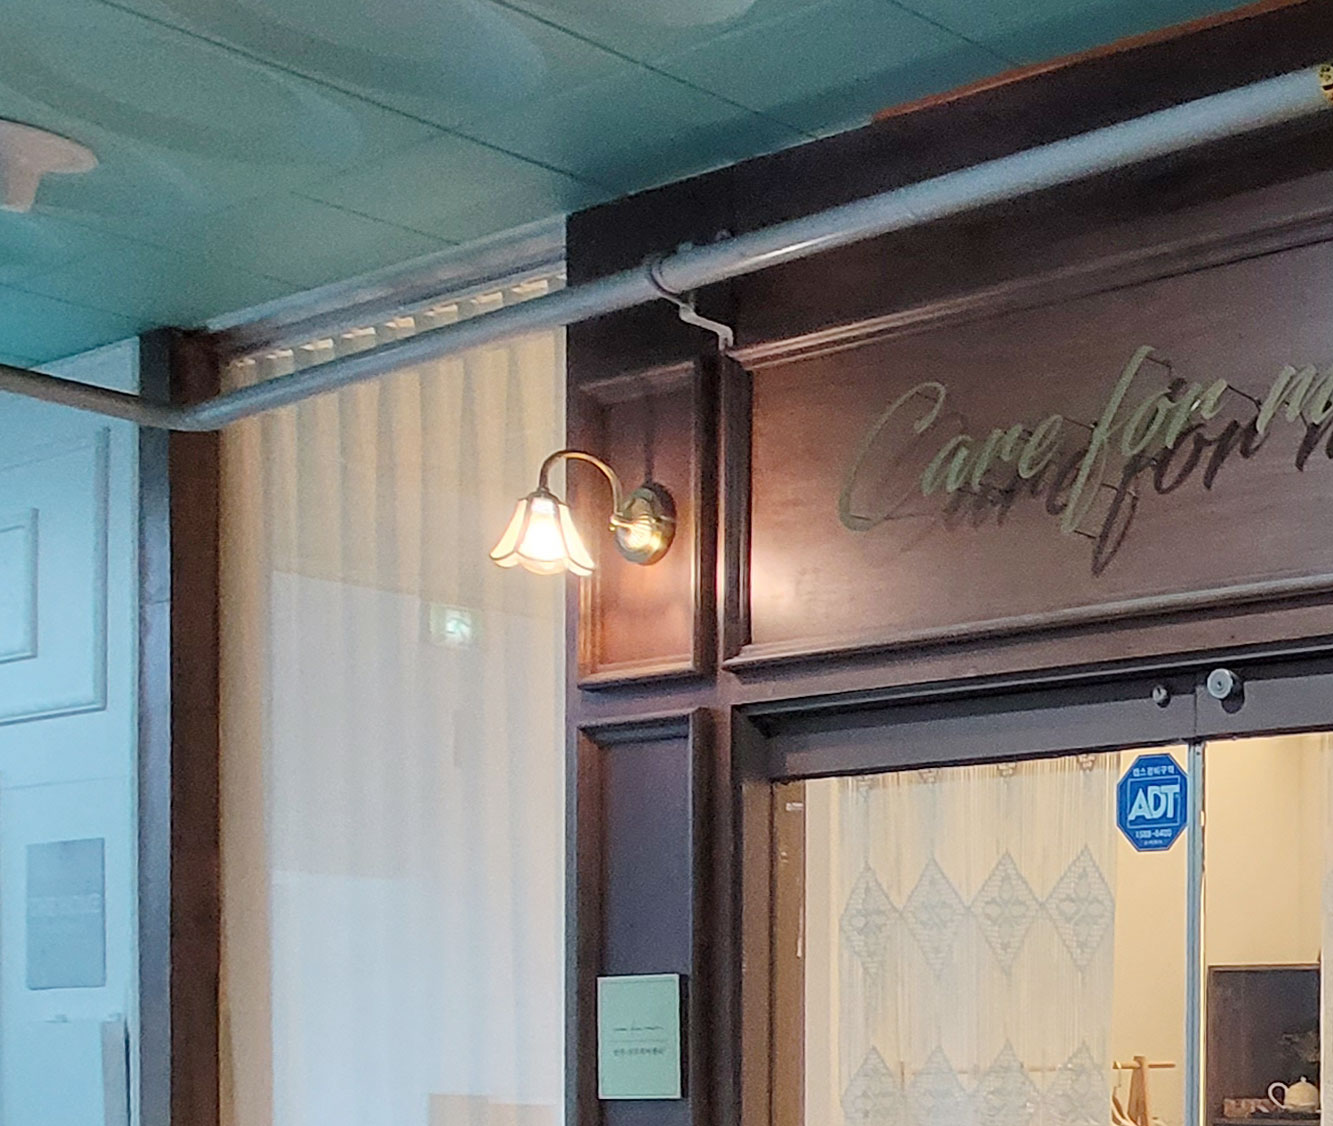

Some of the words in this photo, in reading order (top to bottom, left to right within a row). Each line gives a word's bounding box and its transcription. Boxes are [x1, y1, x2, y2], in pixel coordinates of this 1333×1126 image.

[838, 381, 1064, 533] Care
[1060, 344, 1230, 534] for
[1128, 785, 1180, 820] ADT
